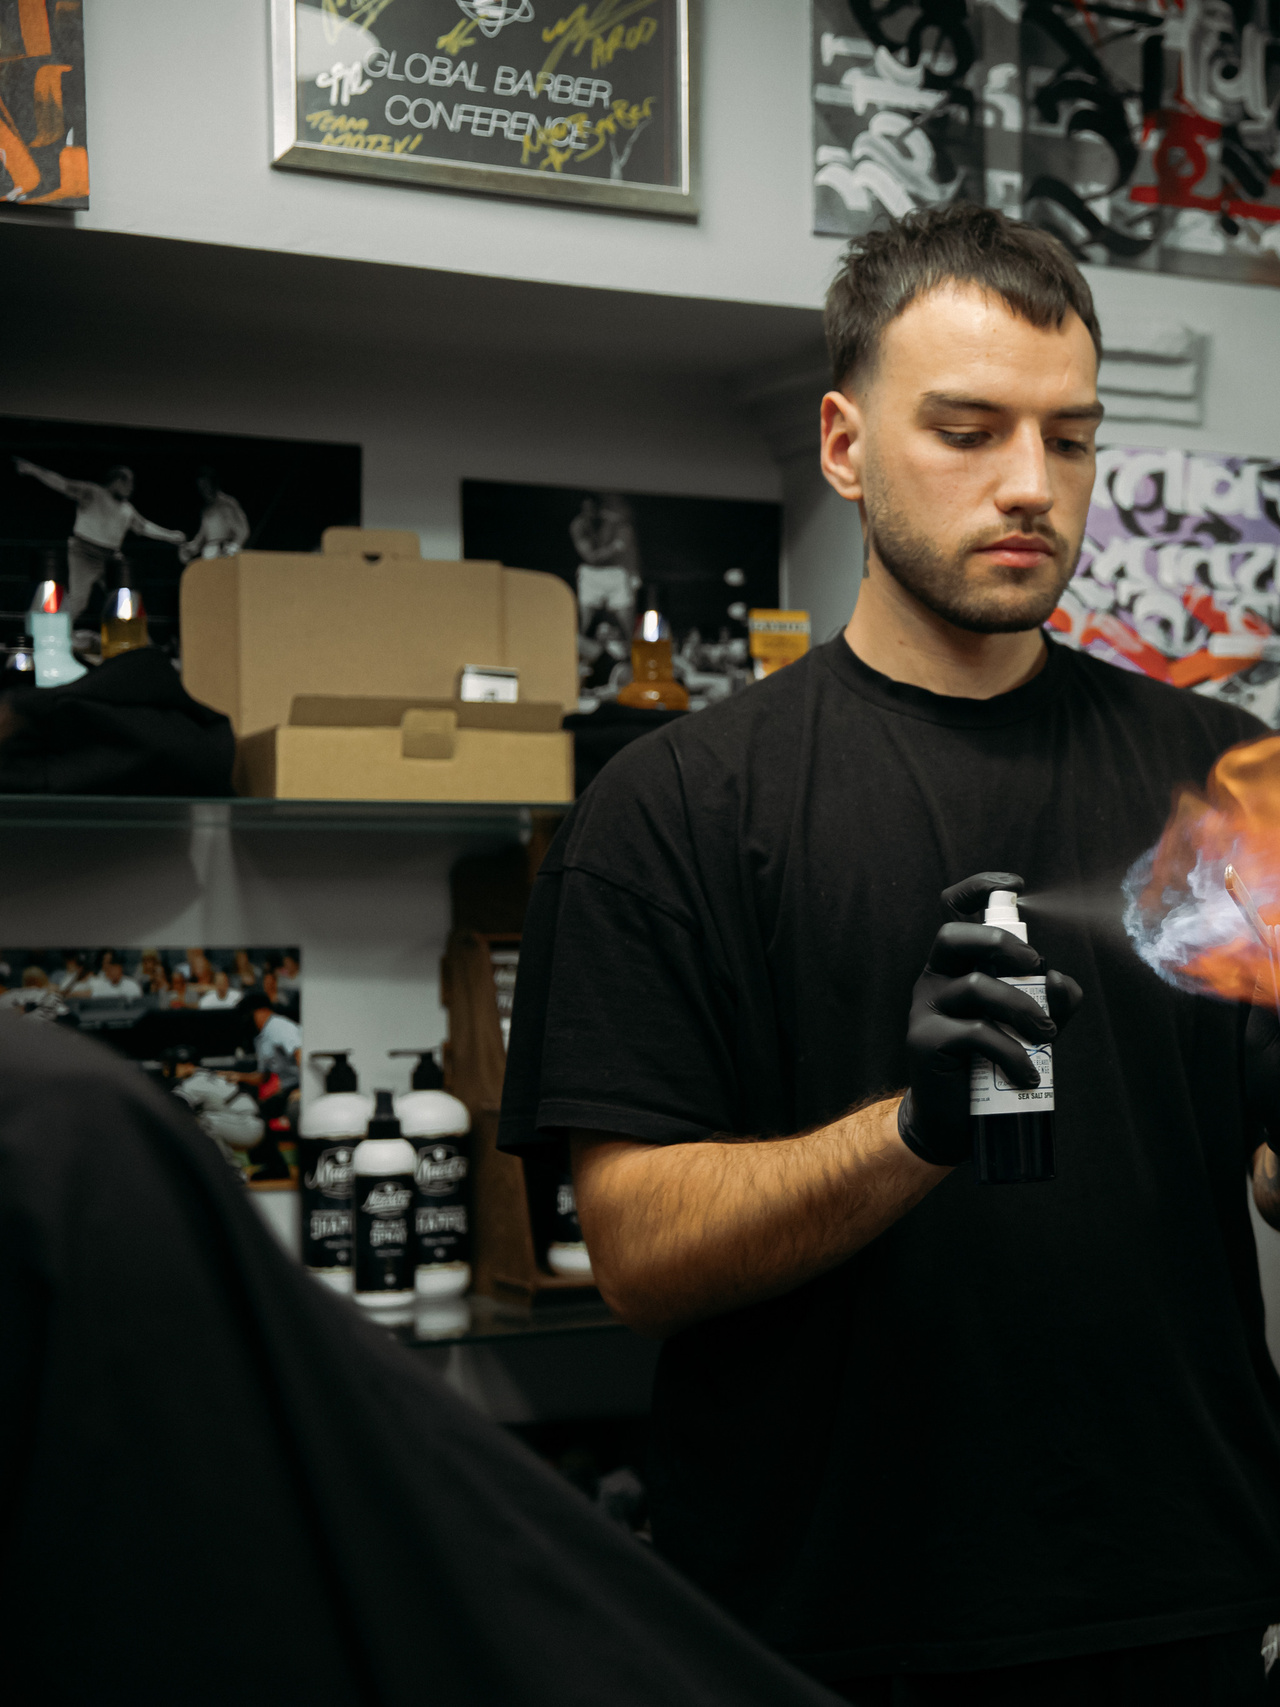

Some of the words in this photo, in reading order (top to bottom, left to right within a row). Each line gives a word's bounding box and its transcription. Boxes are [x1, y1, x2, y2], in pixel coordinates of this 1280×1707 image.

[363, 46, 487, 93] GLOBAL
[493, 65, 613, 109] BARBER
[384, 94, 592, 150] CONFERENCE
[1017, 1092, 1030, 1100] SEA
[1031, 1092, 1043, 1100] SALT
